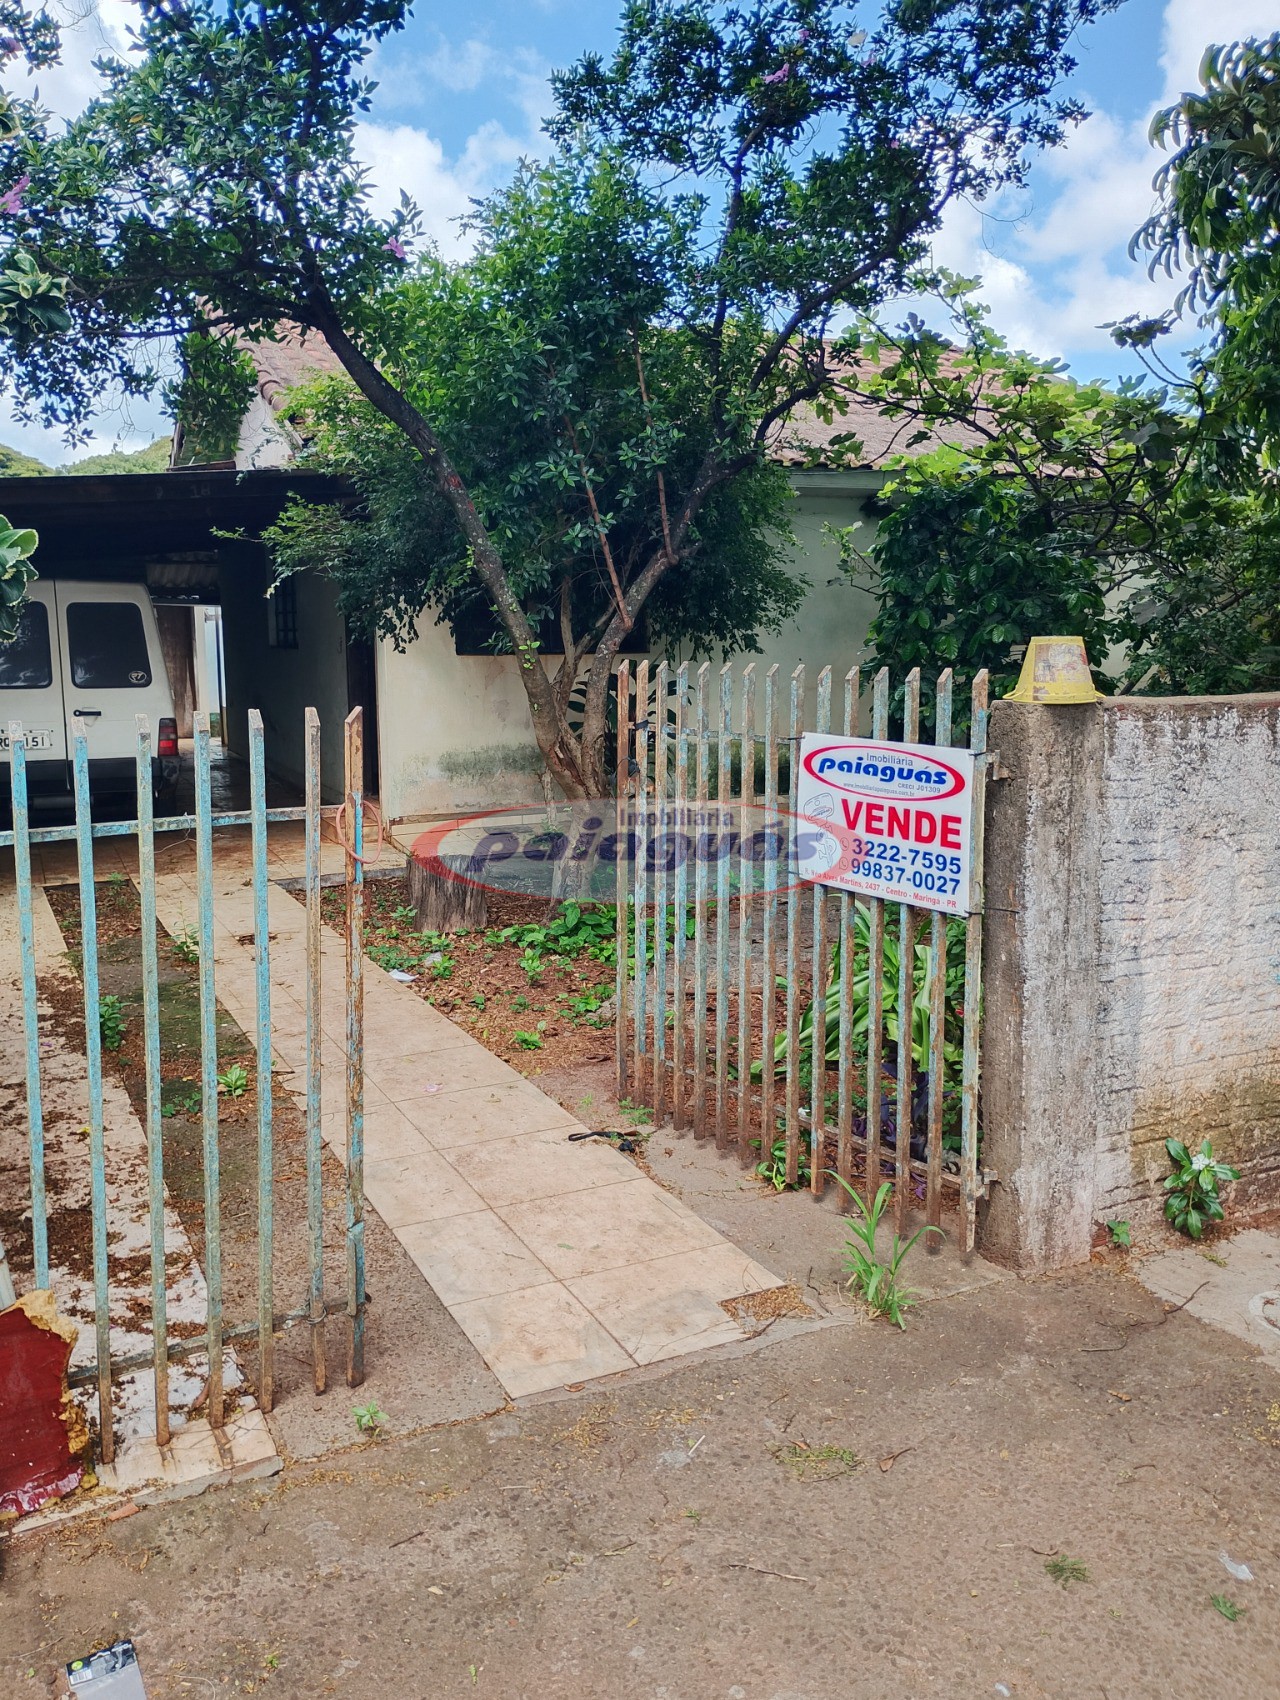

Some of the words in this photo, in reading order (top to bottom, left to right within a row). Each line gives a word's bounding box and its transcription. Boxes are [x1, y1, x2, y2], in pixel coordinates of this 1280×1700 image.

[818, 756, 947, 785] paiaguás
[866, 752, 914, 767] Imobiliária
[897, 782, 915, 790] CRECI
[841, 798, 962, 850] VENDE
[852, 838, 961, 875] 3222-7595
[839, 875, 864, 889] Martins,
[865, 879, 881, 892] 2437
[885, 886, 908, 898] Centro
[947, 899, 957, 909] PR
[851, 858, 960, 895] 99837-0027
